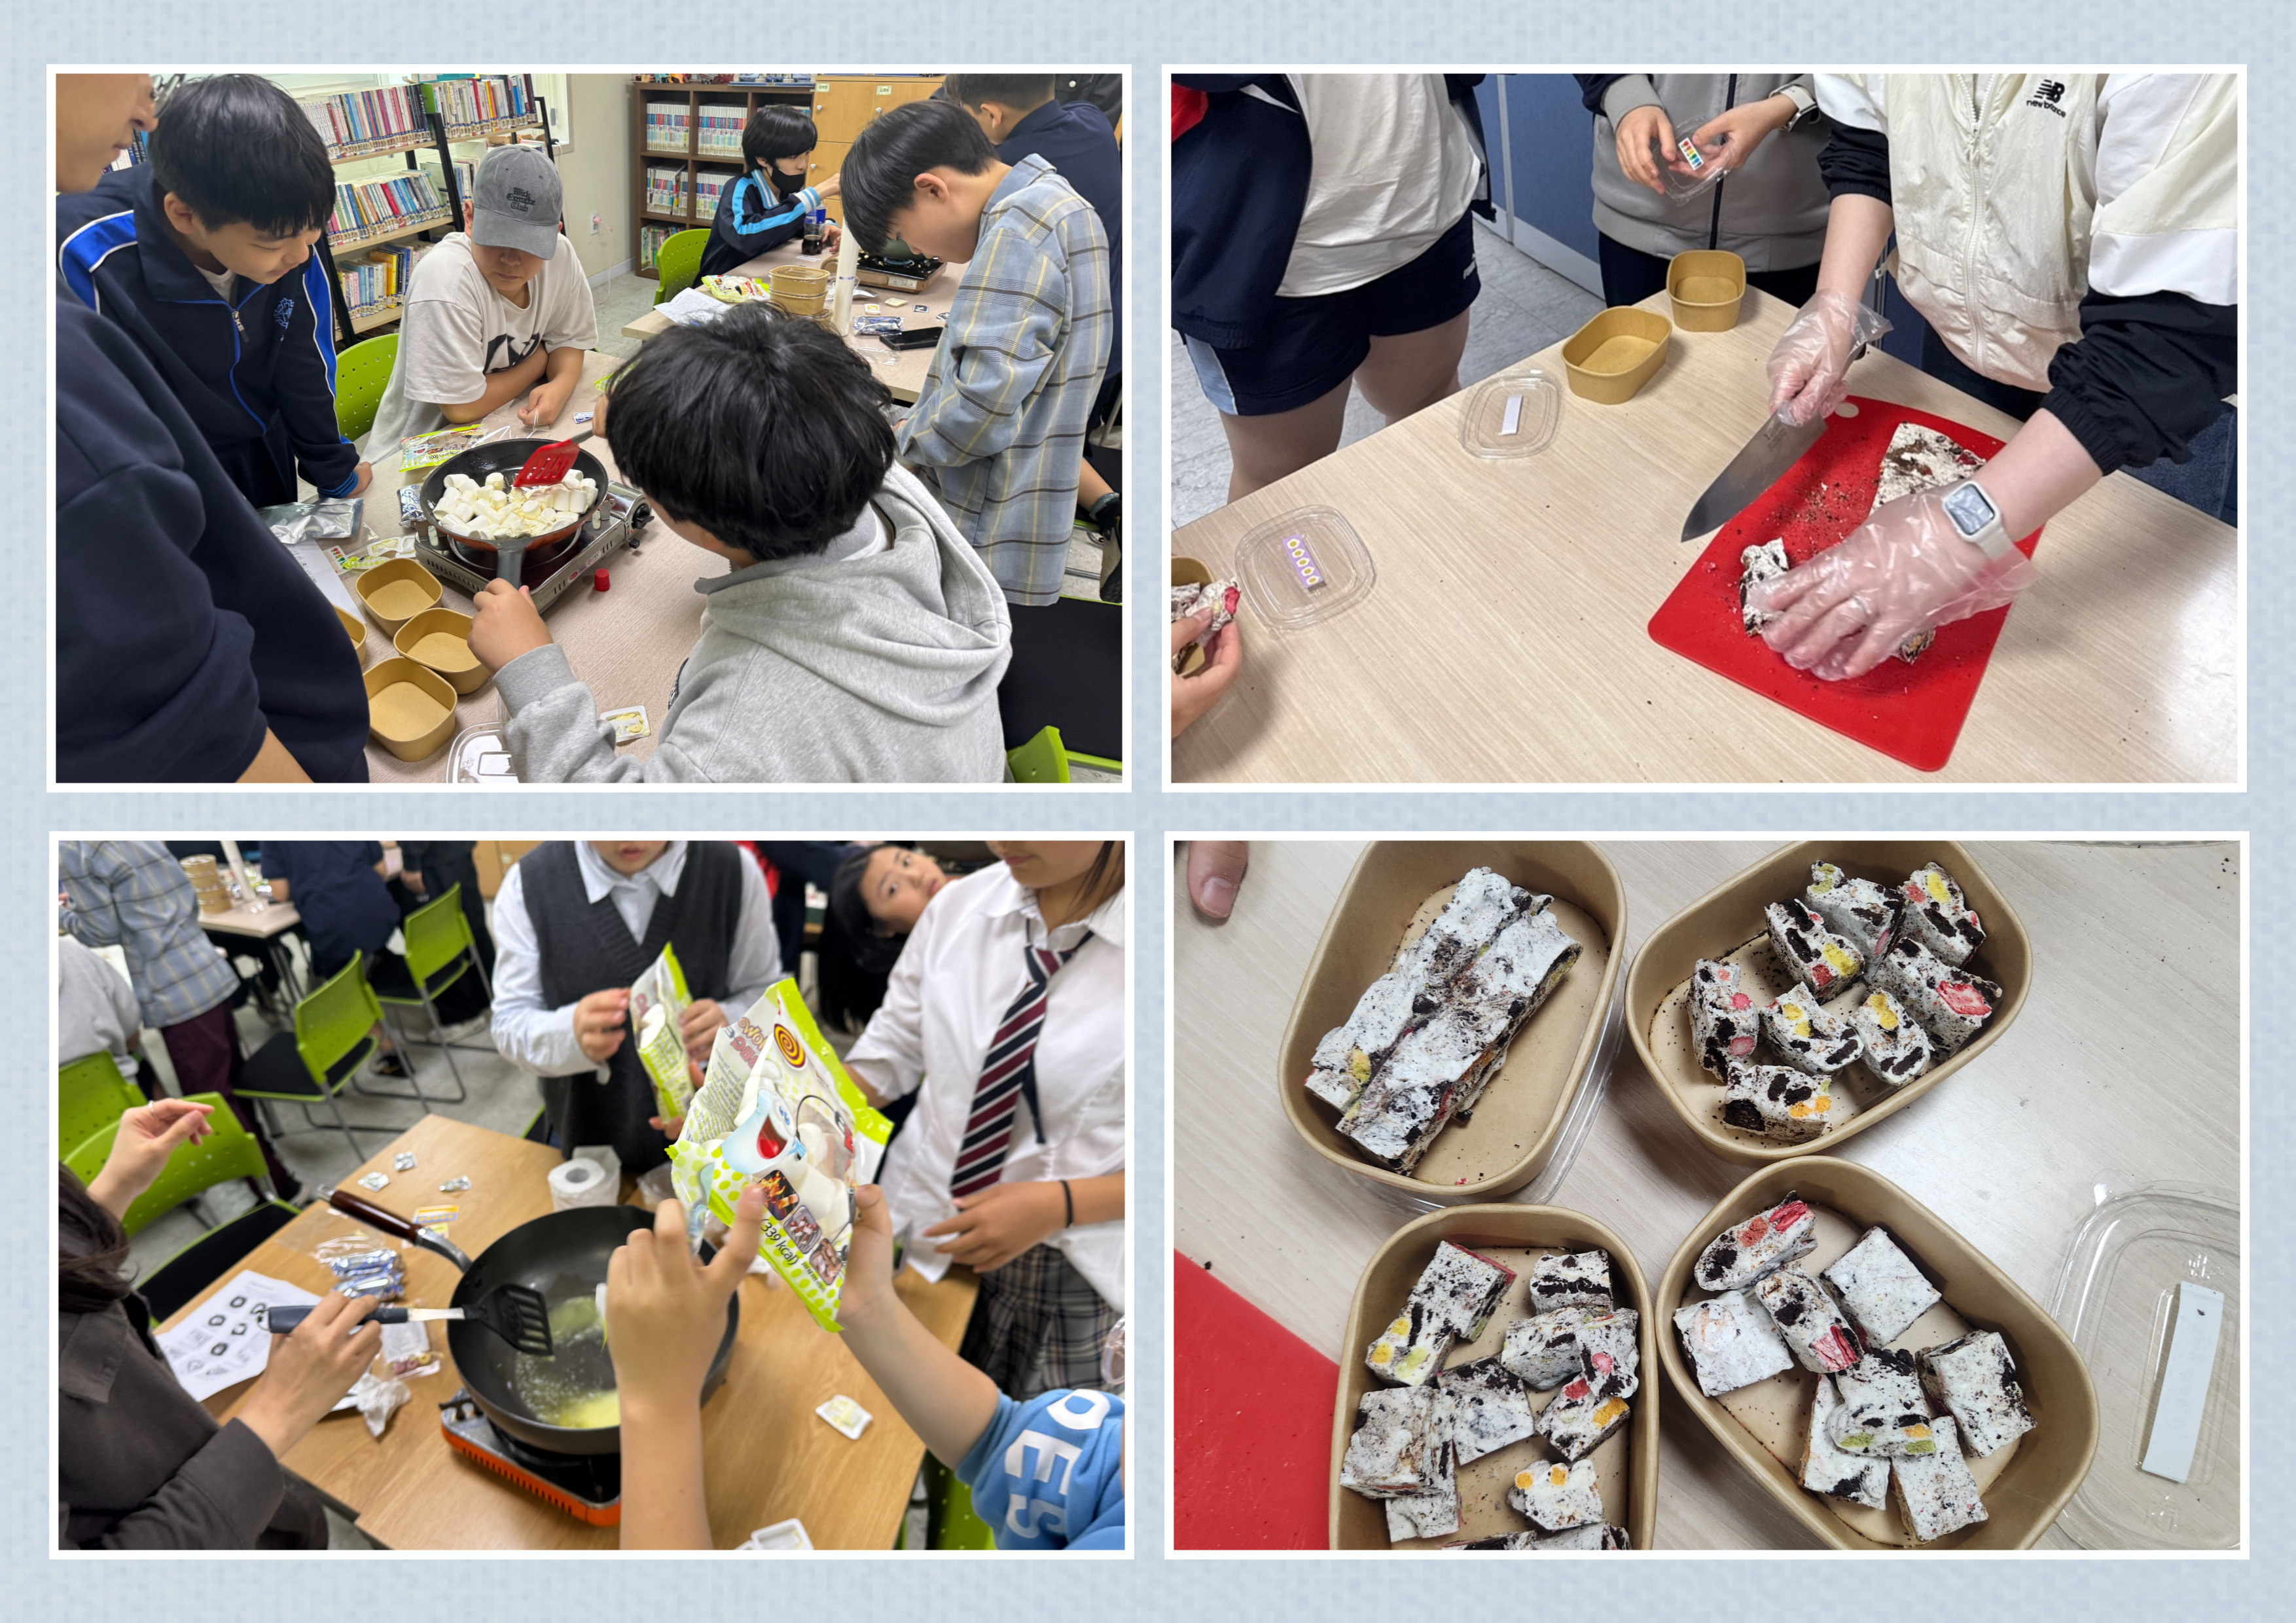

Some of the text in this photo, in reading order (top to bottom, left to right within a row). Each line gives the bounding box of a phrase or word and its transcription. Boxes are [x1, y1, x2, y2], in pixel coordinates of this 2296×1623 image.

[2043, 101, 2066, 118] baance
[511, 202, 528, 211] Club
[775, 1240, 799, 1266] kcal)
